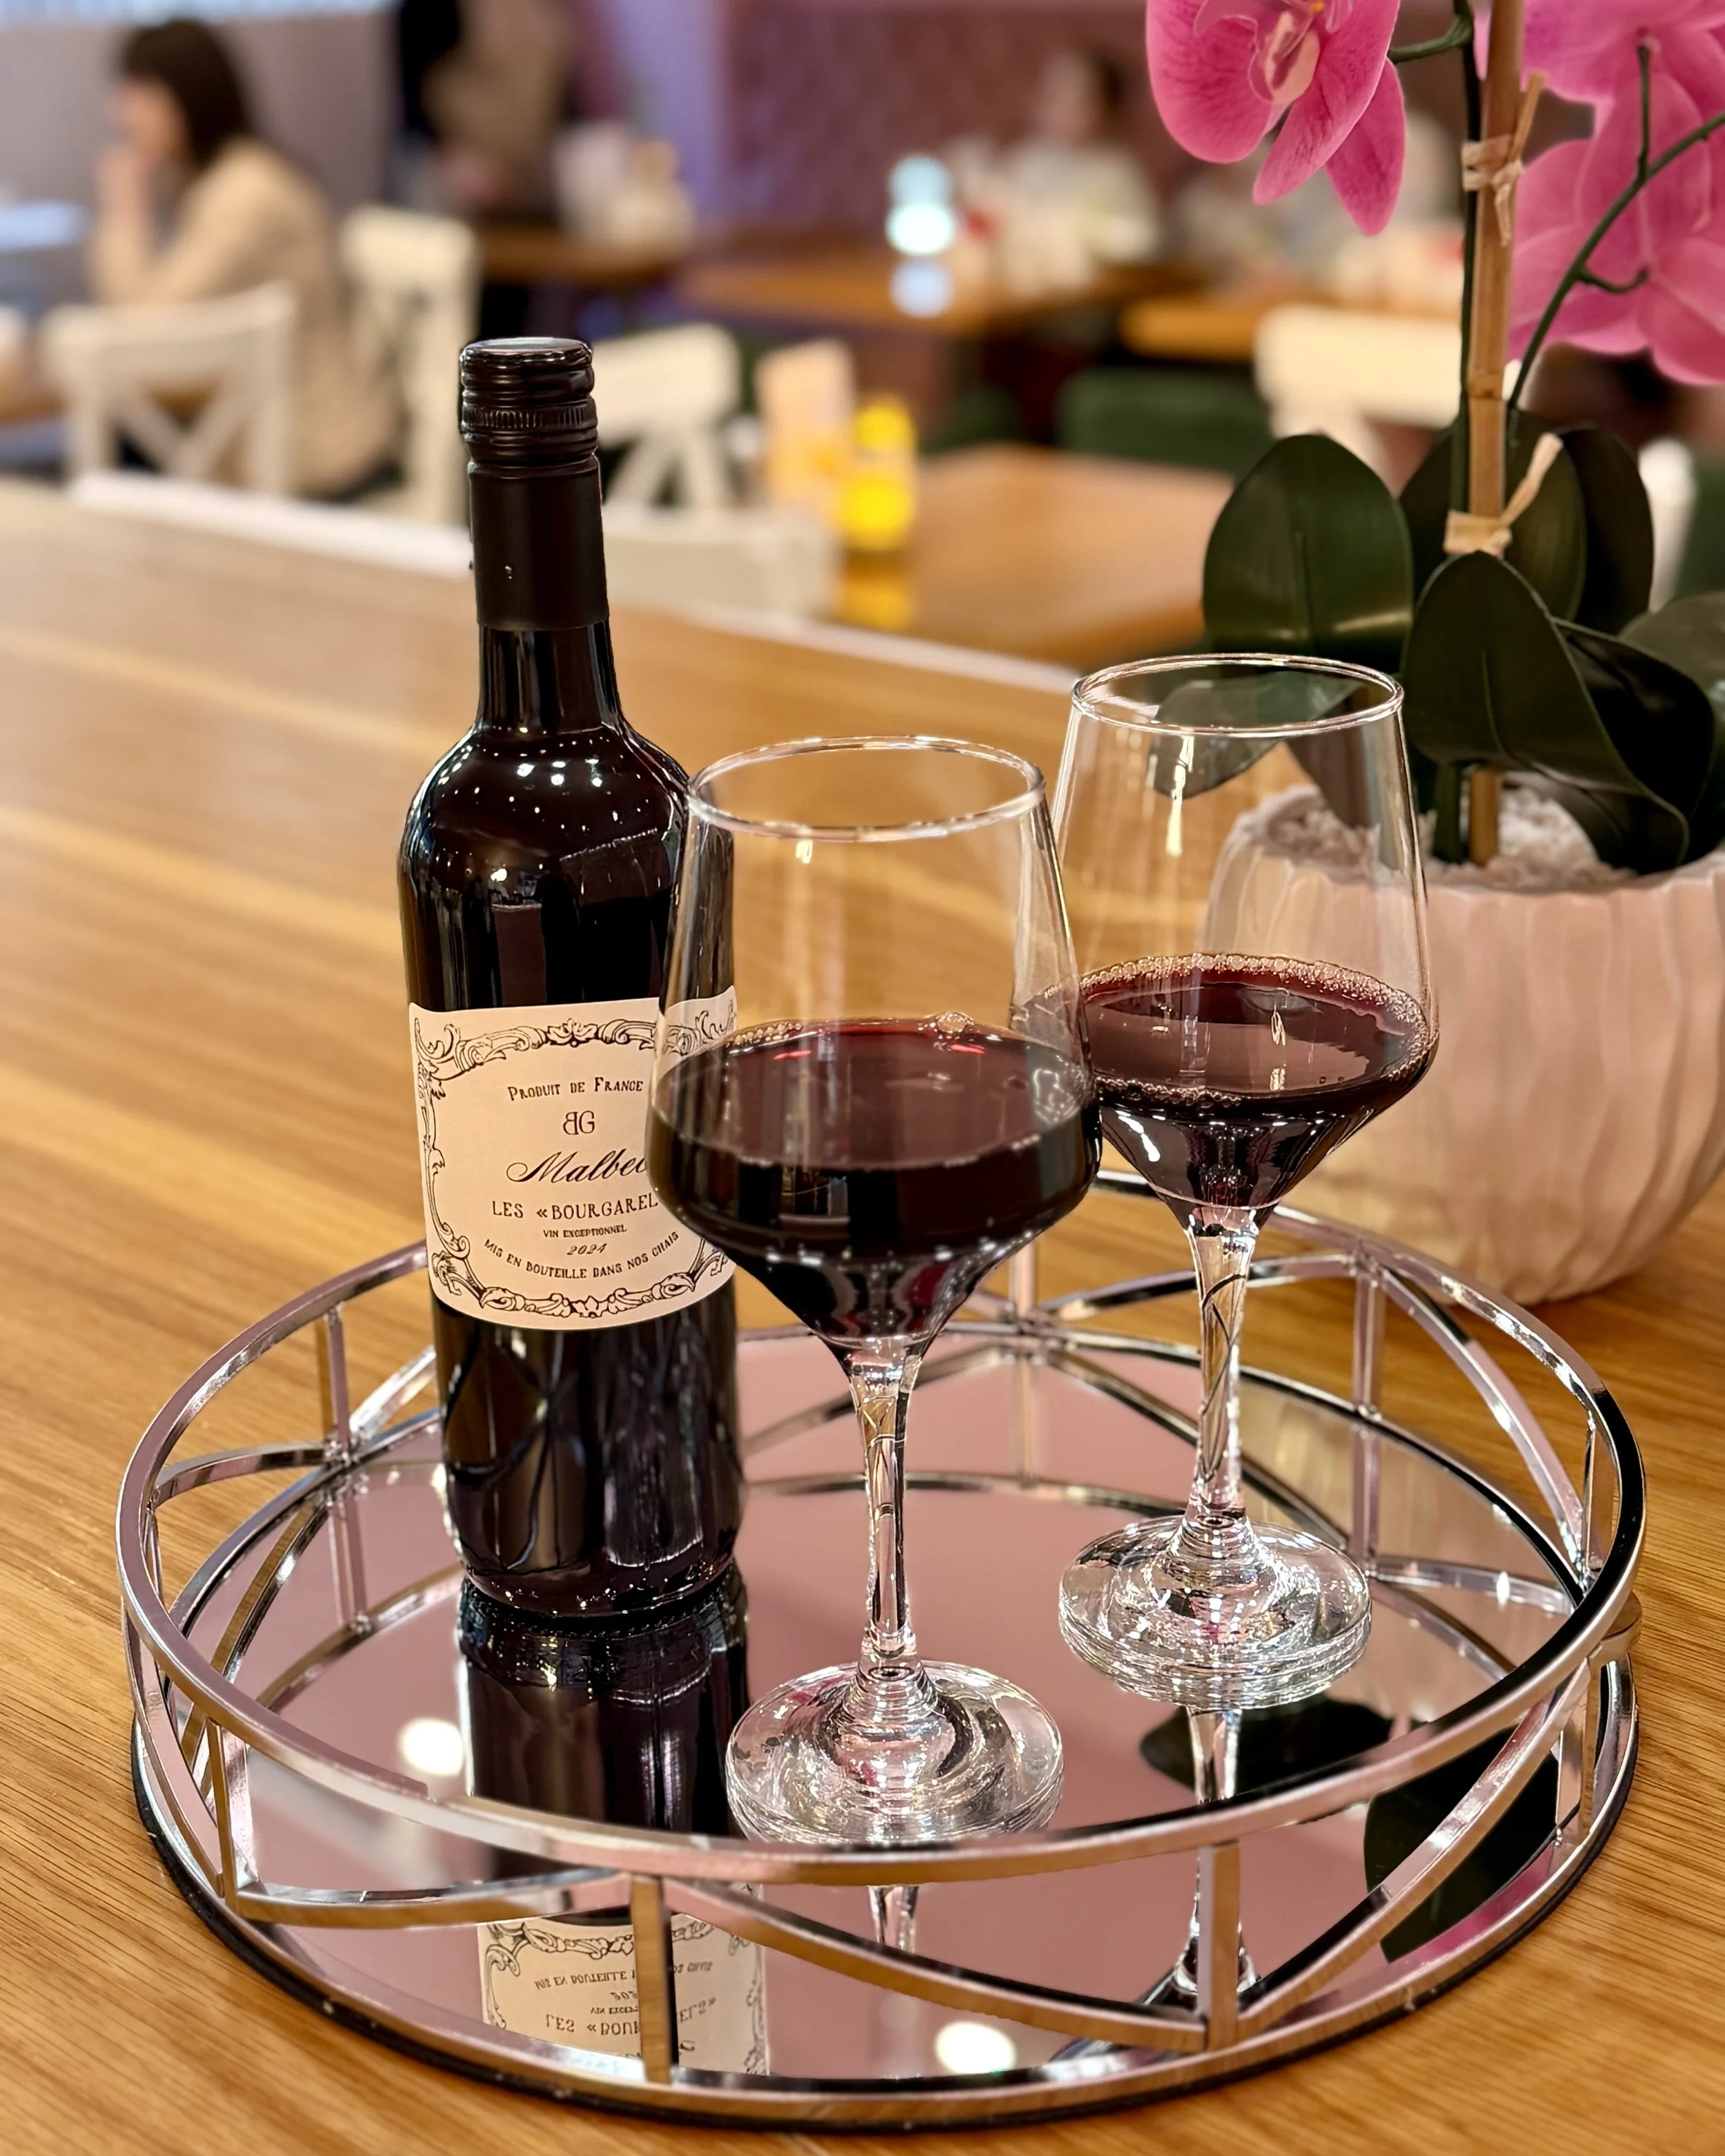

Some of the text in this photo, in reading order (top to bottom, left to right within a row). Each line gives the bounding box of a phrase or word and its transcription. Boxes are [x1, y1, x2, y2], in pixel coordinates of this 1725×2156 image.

[562, 1110, 595, 1135] BG
[492, 1193, 658, 1220] LES «BOURGAREL
[543, 1224, 627, 1238] VIN EXCEPTIONNEL
[484, 1231, 680, 1278] MIS EN BOUTEILLE DANS NOS CHAIS
[566, 1243, 607, 1256] 2024
